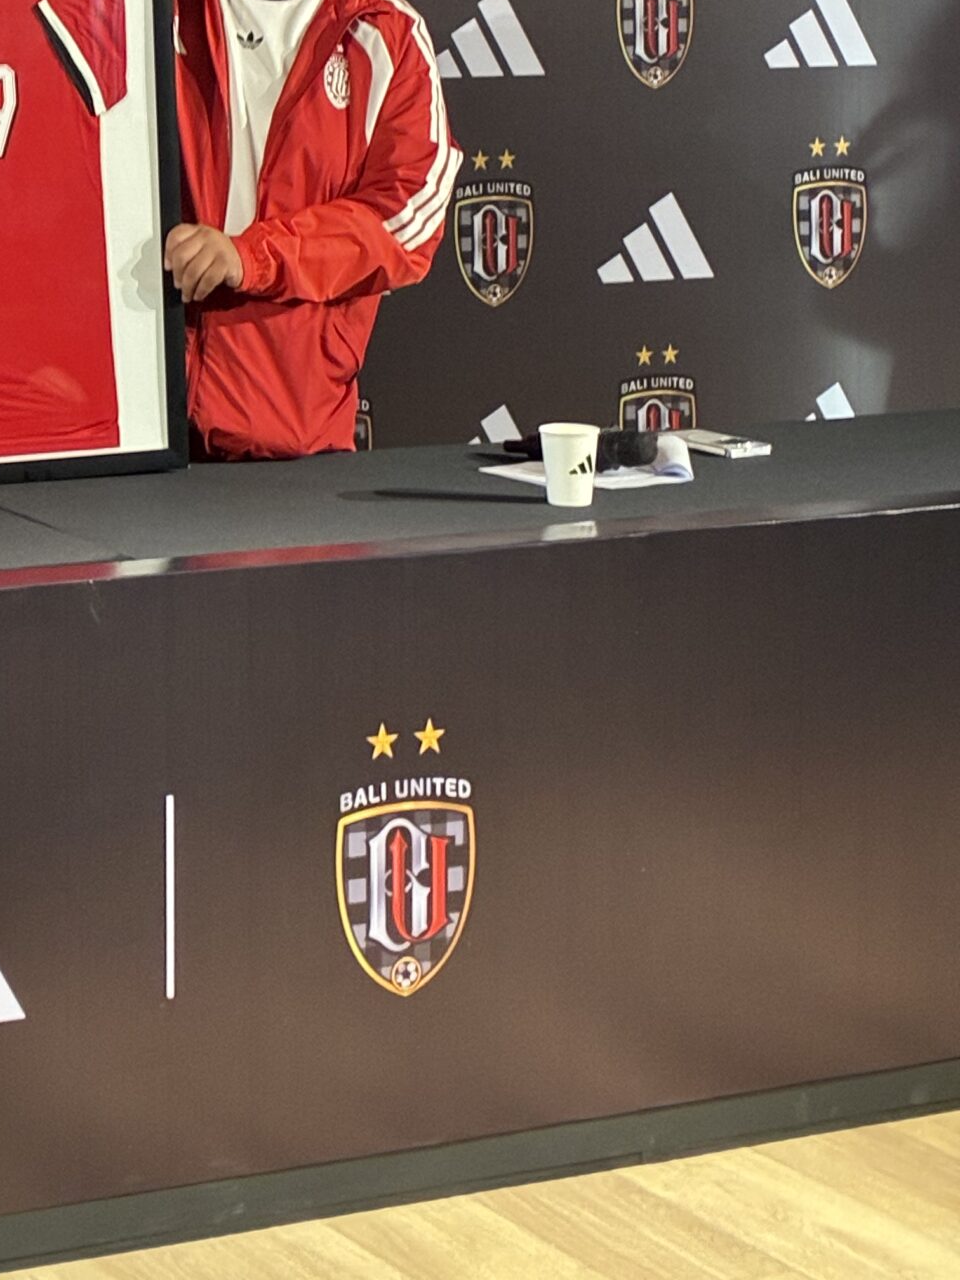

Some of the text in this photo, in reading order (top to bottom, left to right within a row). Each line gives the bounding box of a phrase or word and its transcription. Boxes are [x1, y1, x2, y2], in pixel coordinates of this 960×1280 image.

[794, 167, 865, 185] BALI UNITED
[456, 182, 531, 199] BALI UNITED
[621, 376, 694, 395] BALI UNITED
[340, 776, 472, 813] BALI UNITED
